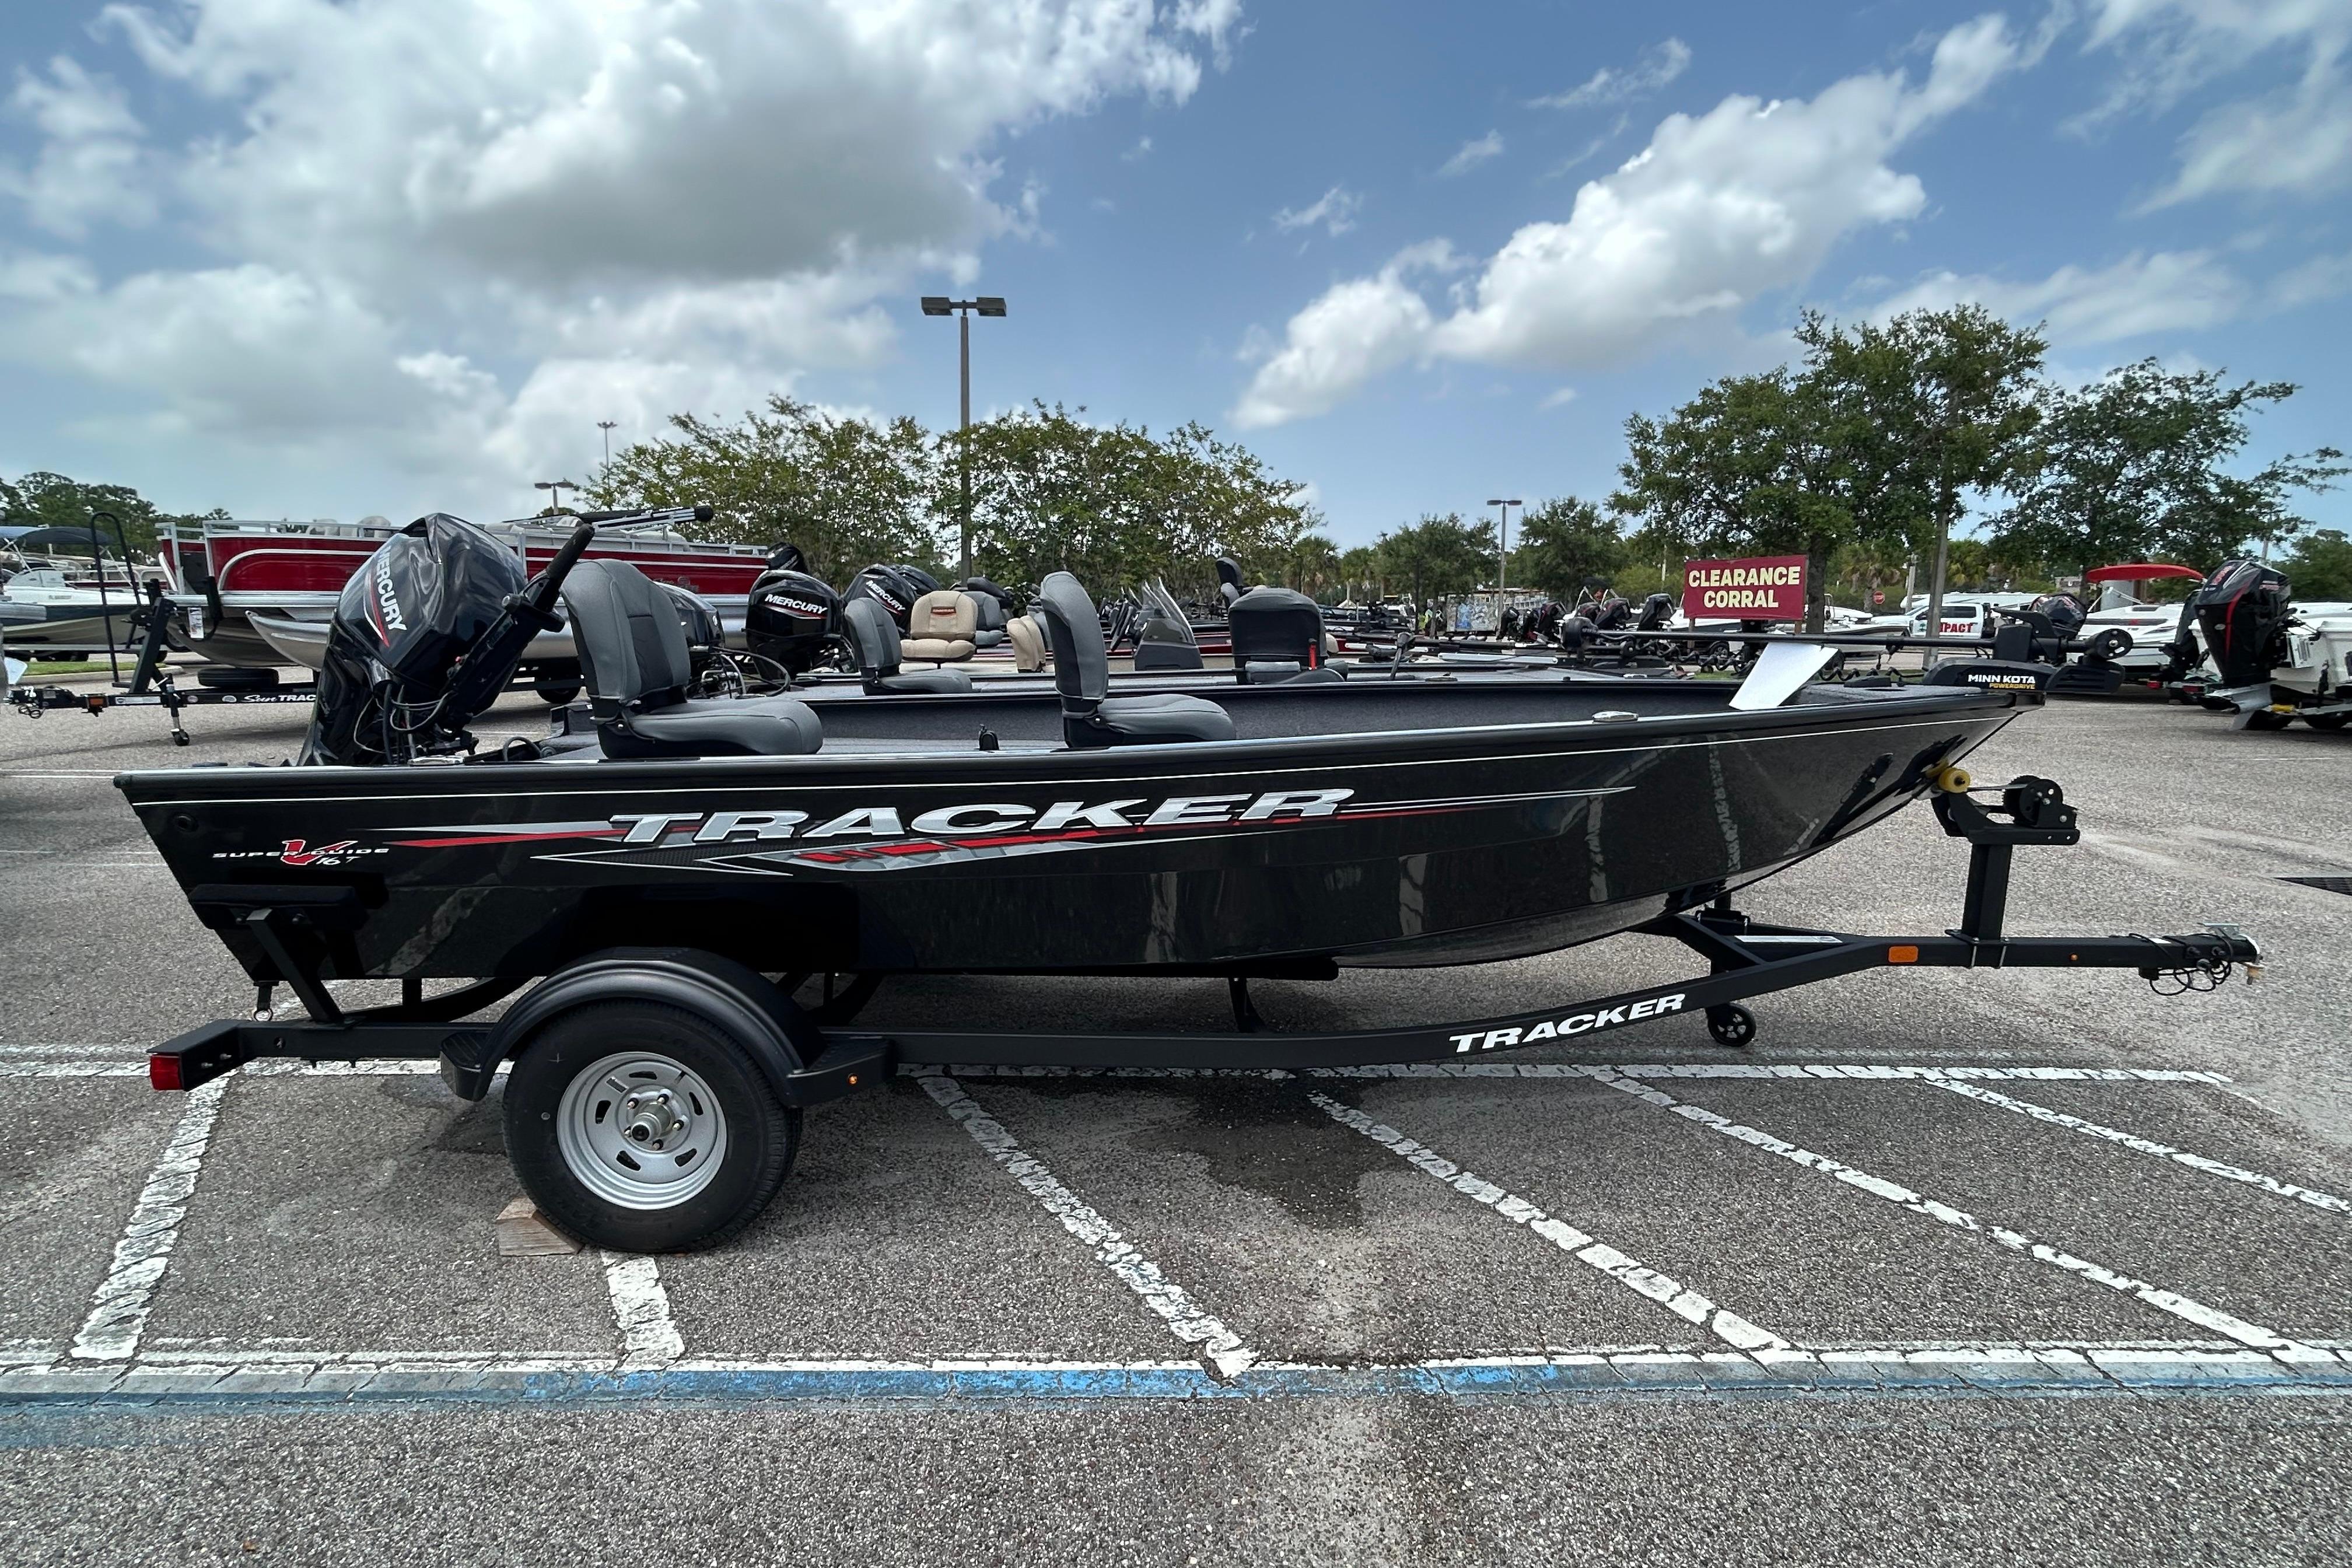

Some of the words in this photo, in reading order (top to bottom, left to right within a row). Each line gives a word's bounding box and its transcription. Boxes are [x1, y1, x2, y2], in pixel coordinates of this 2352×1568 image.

[377, 545, 407, 631] MERCURY
[1688, 566, 1801, 588] CLEARANCE
[764, 593, 828, 615] MERCURY
[866, 579, 907, 611] MERCURY
[1703, 589, 1779, 608] CORRAL
[1968, 674, 2001, 683] MINN
[2002, 675, 2036, 684] KOTA
[610, 788, 1355, 843] TRACKER
[1449, 993, 1686, 1053] TRACKER
